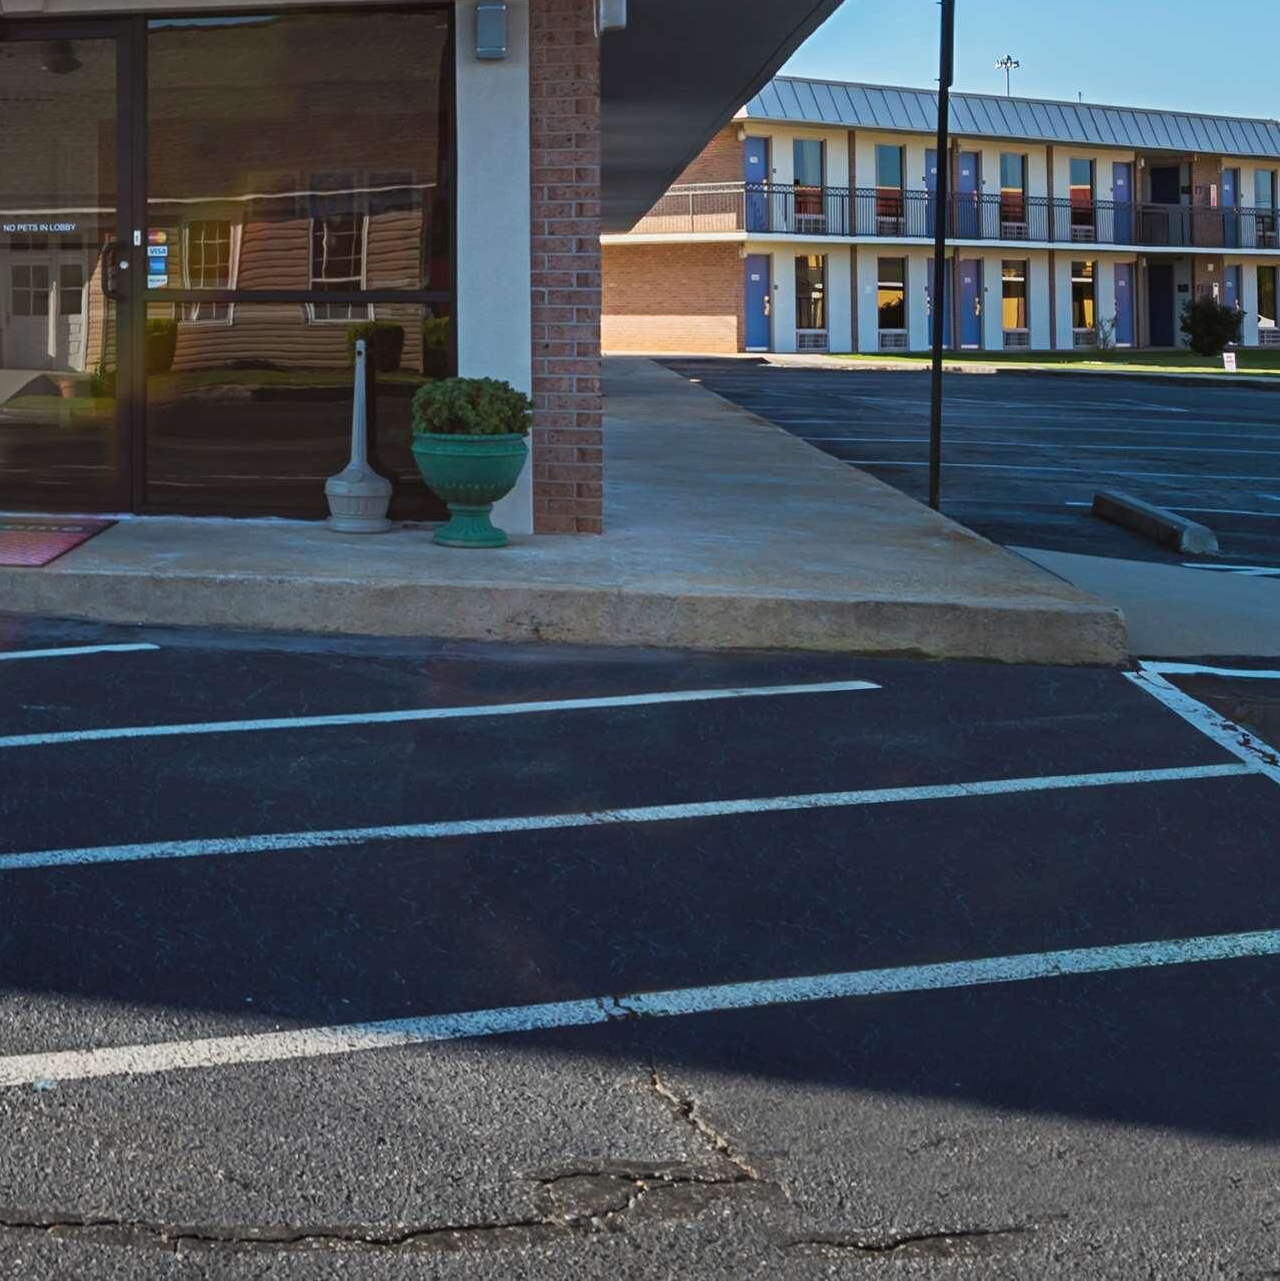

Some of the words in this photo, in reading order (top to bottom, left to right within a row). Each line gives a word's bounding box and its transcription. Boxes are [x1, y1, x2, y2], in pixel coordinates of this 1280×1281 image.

[2, 223, 16, 232] NO
[17, 223, 38, 232] PETS
[49, 222, 77, 231] LOBBY
